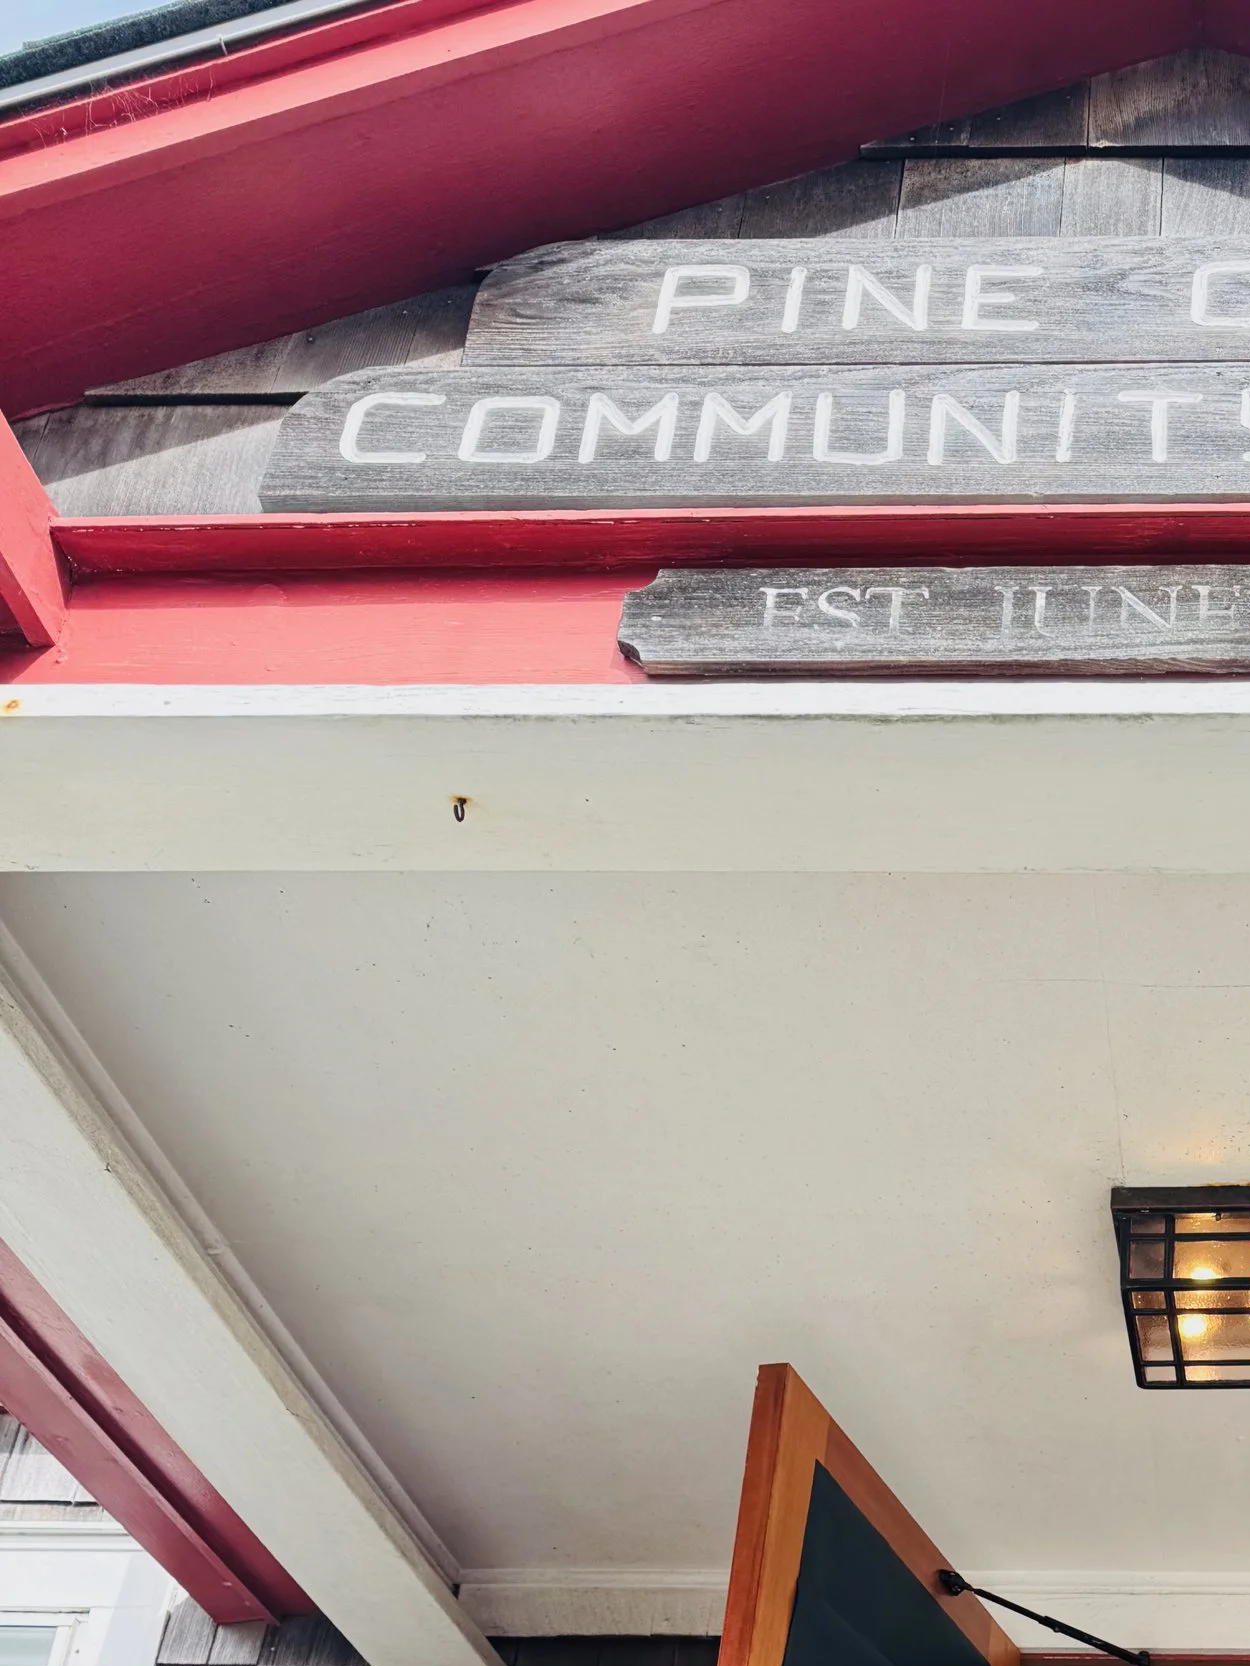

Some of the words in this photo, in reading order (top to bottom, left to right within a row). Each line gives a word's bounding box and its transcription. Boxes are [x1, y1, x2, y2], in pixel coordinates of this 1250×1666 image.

[651, 263, 1043, 334] PINE
[758, 586, 930, 635] EST
[993, 584, 1241, 638] JUNE
